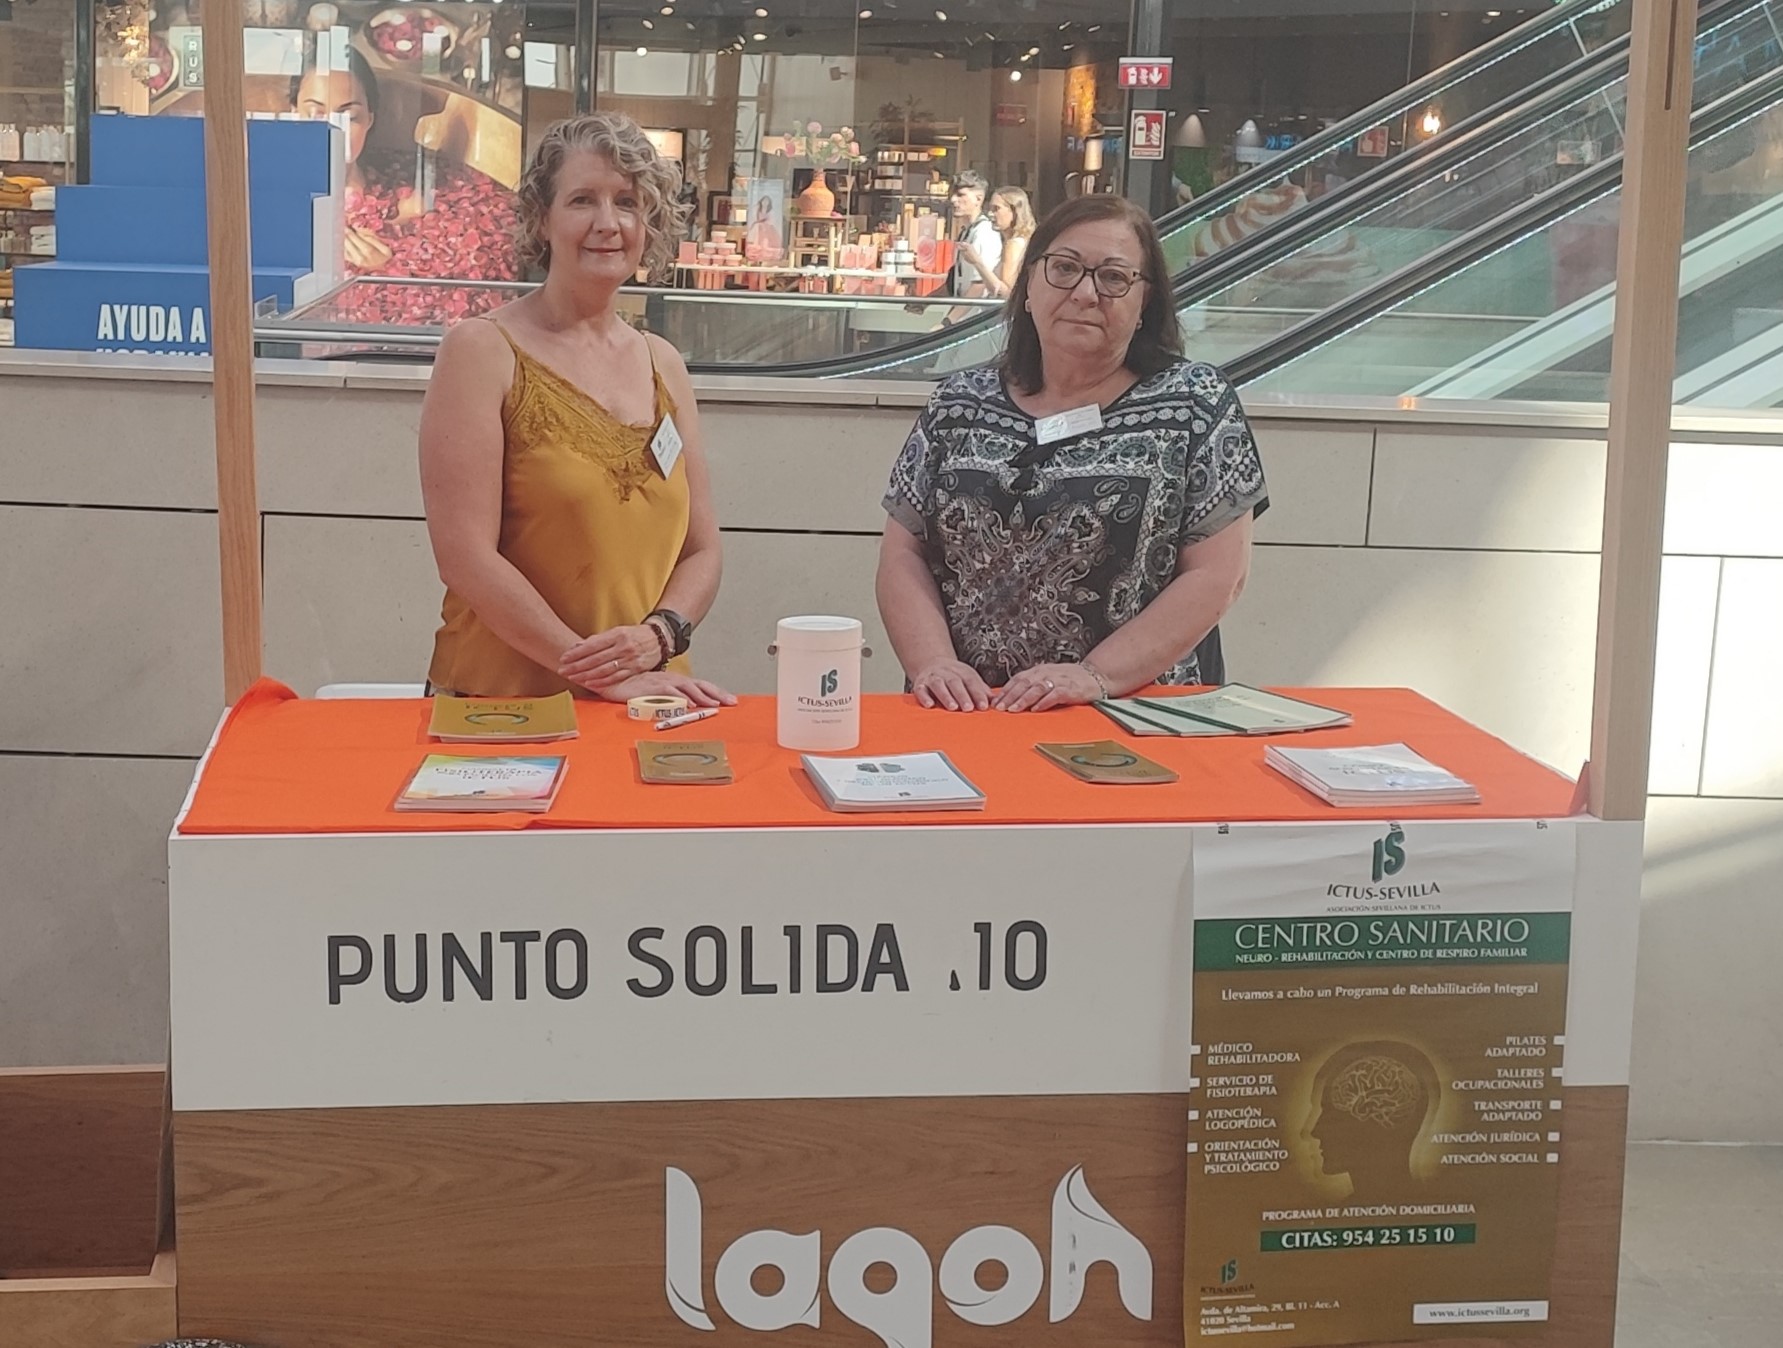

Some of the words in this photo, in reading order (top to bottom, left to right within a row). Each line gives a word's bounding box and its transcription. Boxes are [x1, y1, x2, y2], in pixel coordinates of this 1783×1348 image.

[98, 304, 183, 342] AYUDA
[190, 307, 207, 343] A
[1372, 831, 1405, 883] IS
[1327, 882, 1440, 901] ICTUS-SEVILLA
[1235, 921, 1359, 949] CENTRO
[1368, 918, 1529, 946] SANITARIO
[1235, 953, 1272, 963] NEURO
[1281, 949, 1365, 962] REHABILITACIÓN
[1367, 950, 1372, 960] Y
[1376, 949, 1417, 959] CENTRO
[1420, 949, 1433, 959] DE
[1436, 949, 1478, 958] RESPIRO
[1480, 947, 1527, 957] FAMILIAR
[328, 929, 588, 1004] PUNTO
[626, 921, 1047, 998] SOLIDAIO
[1221, 988, 1274, 1000] Llevamos
[1277, 990, 1283, 998] a
[1287, 987, 1314, 998] cabo
[1317, 989, 1332, 997] un
[1335, 986, 1389, 999] Programa
[1392, 984, 1406, 995] de
[1409, 983, 1491, 995] Rehabilitación
[1494, 982, 1538, 996] Integral
[1505, 1036, 1547, 1045] PILATES
[1208, 1042, 1253, 1054] MÉDICO
[1485, 1047, 1546, 1057] ADAPTADO
[1207, 1052, 1301, 1065] REHABILITADORA
[1497, 1068, 1545, 1078] TALLERES
[1206, 1076, 1256, 1087] SERVICIO
[1259, 1074, 1274, 1084] DE
[1451, 1079, 1544, 1090] OCUPACIONALES
[1206, 1086, 1278, 1098] FISIOTERAPIA
[1473, 1100, 1542, 1110] TRANSPORTE
[1205, 1106, 1262, 1119] ATENCIÓN
[1481, 1111, 1542, 1121] ADAPTADO
[1205, 1117, 1277, 1130] LOGOPÉDICA
[1432, 1131, 1487, 1143] ATENCIÓN
[1490, 1130, 1541, 1142] JURÍDICA
[1204, 1138, 1280, 1152] ORIENTACIÓN
[1204, 1153, 1212, 1162] Y
[1214, 1149, 1289, 1161] TRATAMIENTO
[1441, 1152, 1497, 1164] ATENCIÓN
[1499, 1153, 1540, 1163] SOCIAL
[1204, 1161, 1281, 1174] PSICOLÓGICO
[1262, 1208, 1323, 1221] PROGRAMA
[1325, 1207, 1340, 1218] DE
[1342, 1204, 1397, 1217] ATENCIÓN
[1399, 1203, 1476, 1216] DOMICILIARIA
[1281, 1231, 1339, 1249] CITAS:
[1342, 1230, 1375, 1246] 954
[1379, 1228, 1401, 1244] 25
[1406, 1227, 1428, 1244] 15
[1433, 1226, 1455, 1243] 10
[1429, 1306, 1530, 1318] www.ictussevilla.org
